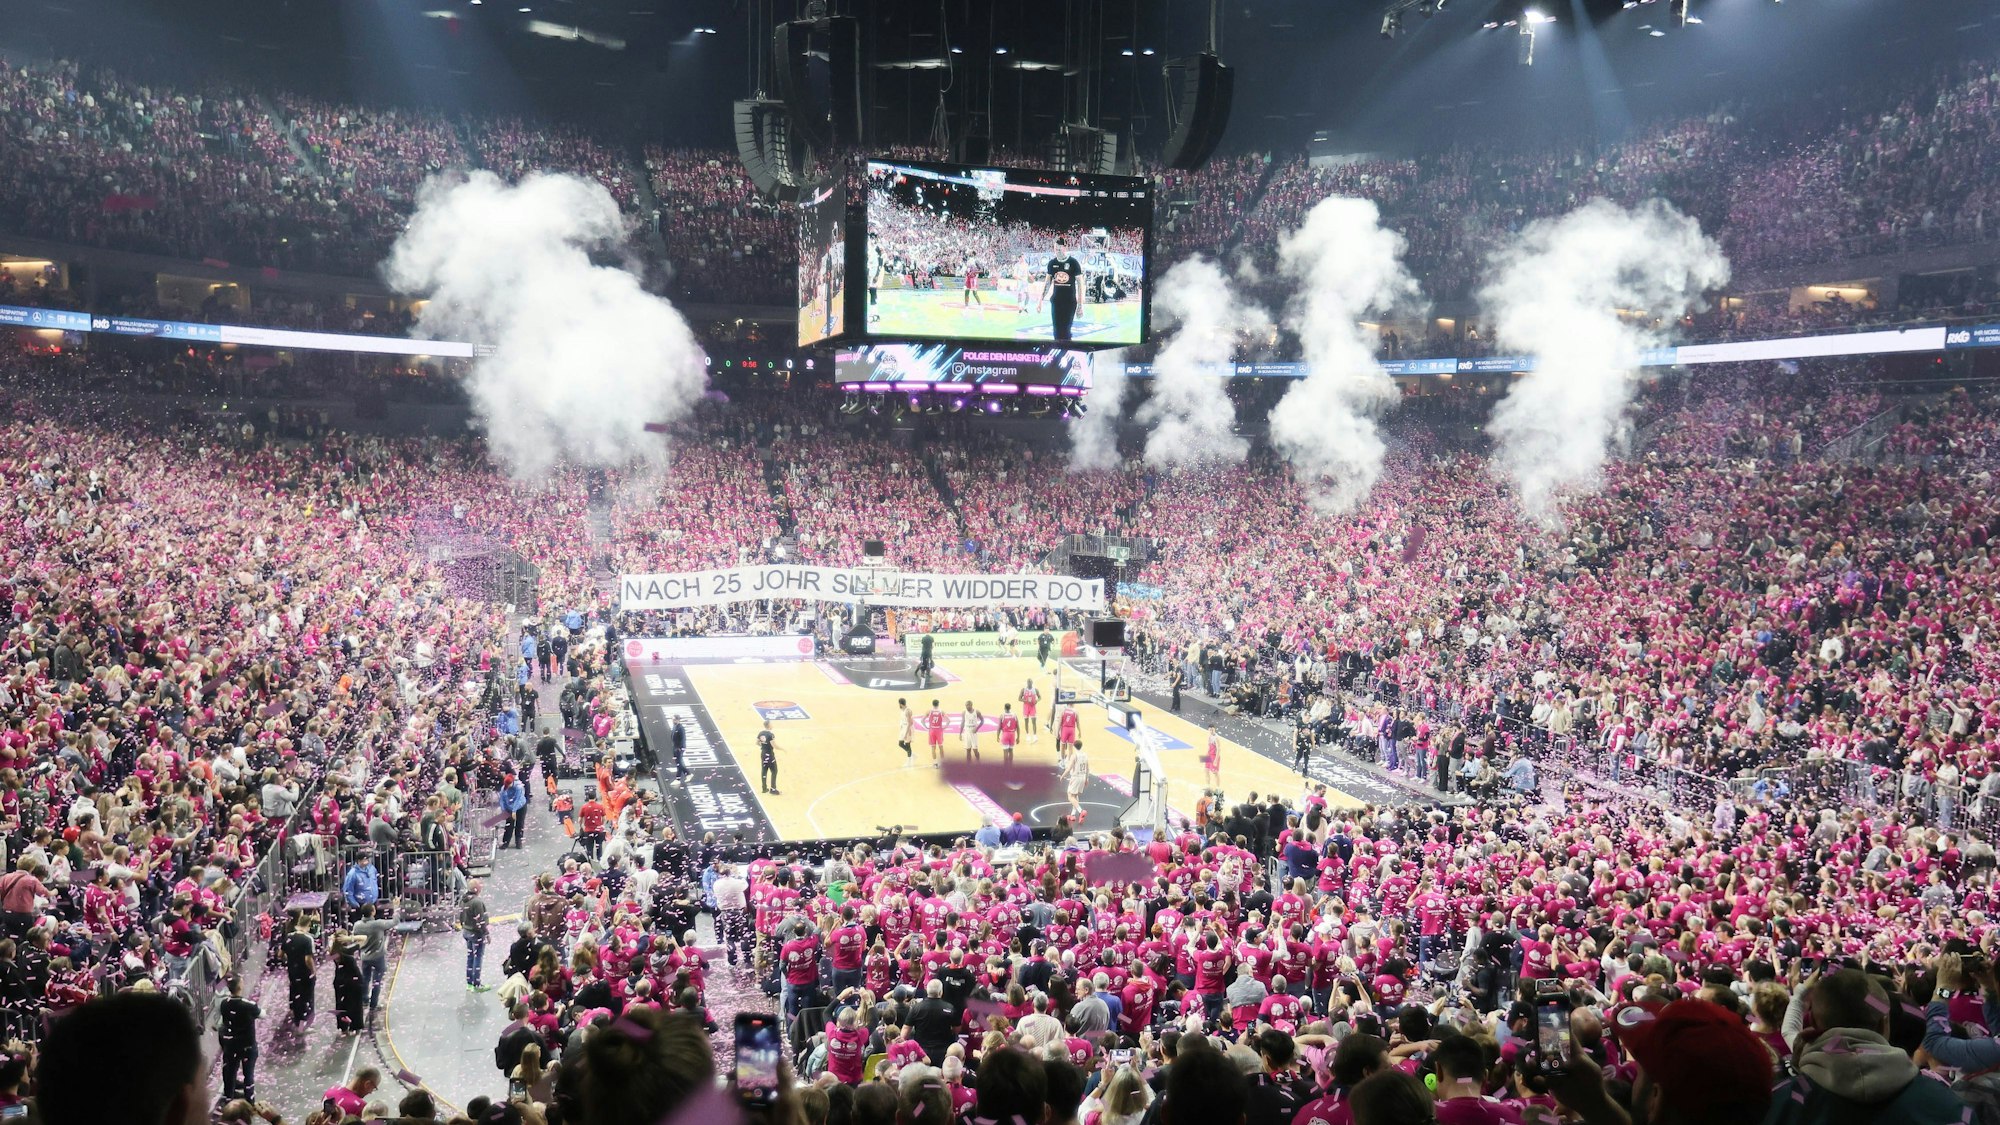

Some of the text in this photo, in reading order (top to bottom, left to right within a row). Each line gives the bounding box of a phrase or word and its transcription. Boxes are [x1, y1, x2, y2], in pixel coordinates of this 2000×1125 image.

[1947, 330, 1970, 343] RKG
[705, 356, 711, 366] 0
[963, 352, 989, 361] FOLGE
[990, 352, 1007, 361] DEN
[1007, 353, 1039, 362] BASKETS
[786, 359, 793, 369] 0
[968, 365, 1017, 377] Instagram
[625, 577, 701, 601] NACH
[713, 573, 741, 594] 25
[753, 569, 820, 592] JOHR
[943, 579, 1038, 600] WIDDER
[1048, 582, 1082, 602] DO
[851, 636, 872, 646] RKG
[960, 638, 974, 647] auf
[871, 969, 884, 980] 21
